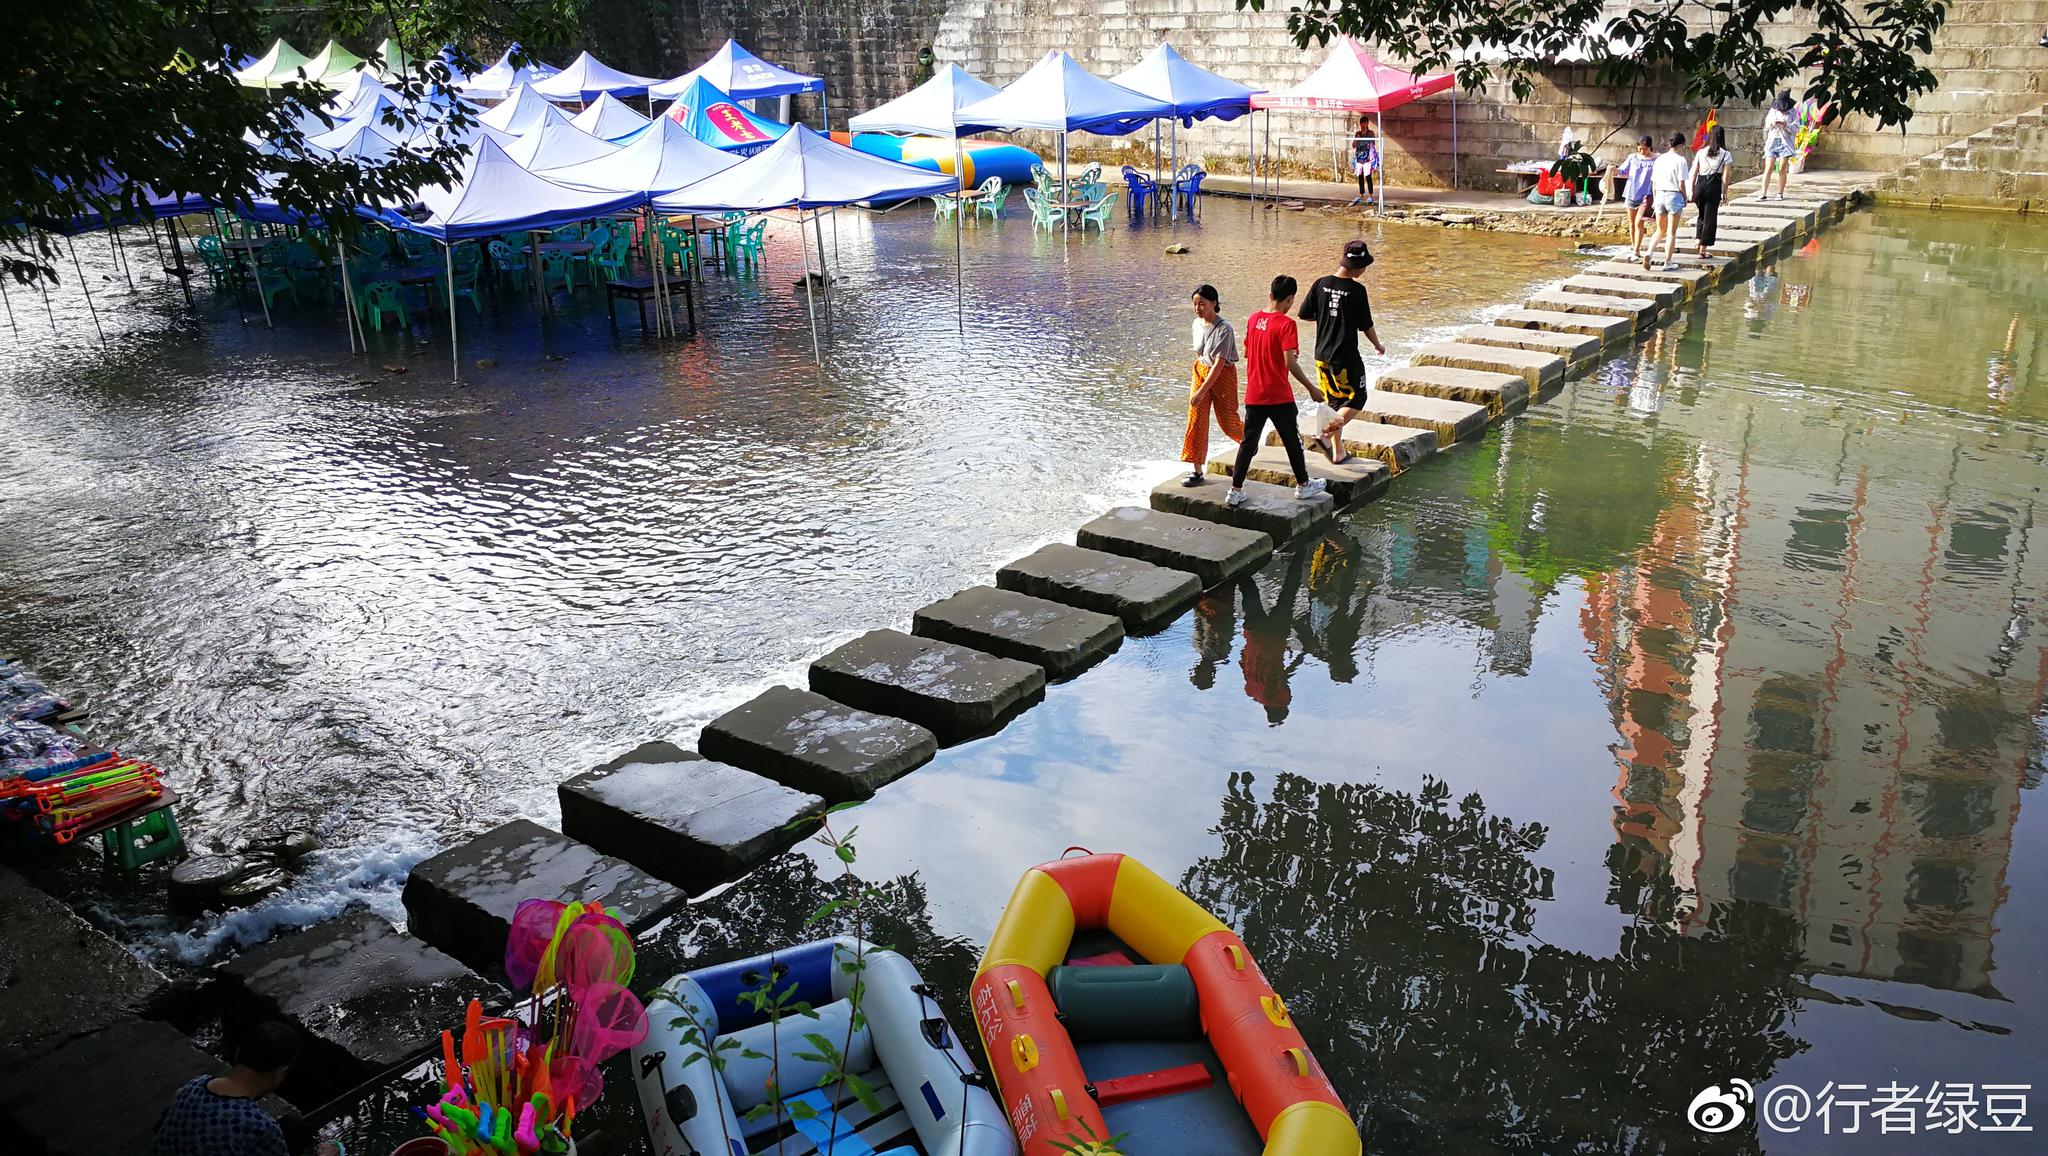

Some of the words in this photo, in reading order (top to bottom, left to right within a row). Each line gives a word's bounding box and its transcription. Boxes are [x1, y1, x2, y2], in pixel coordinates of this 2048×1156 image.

[976, 983, 1003, 1047] 奇石谷
[1011, 1093, 1039, 1152] 漂流
